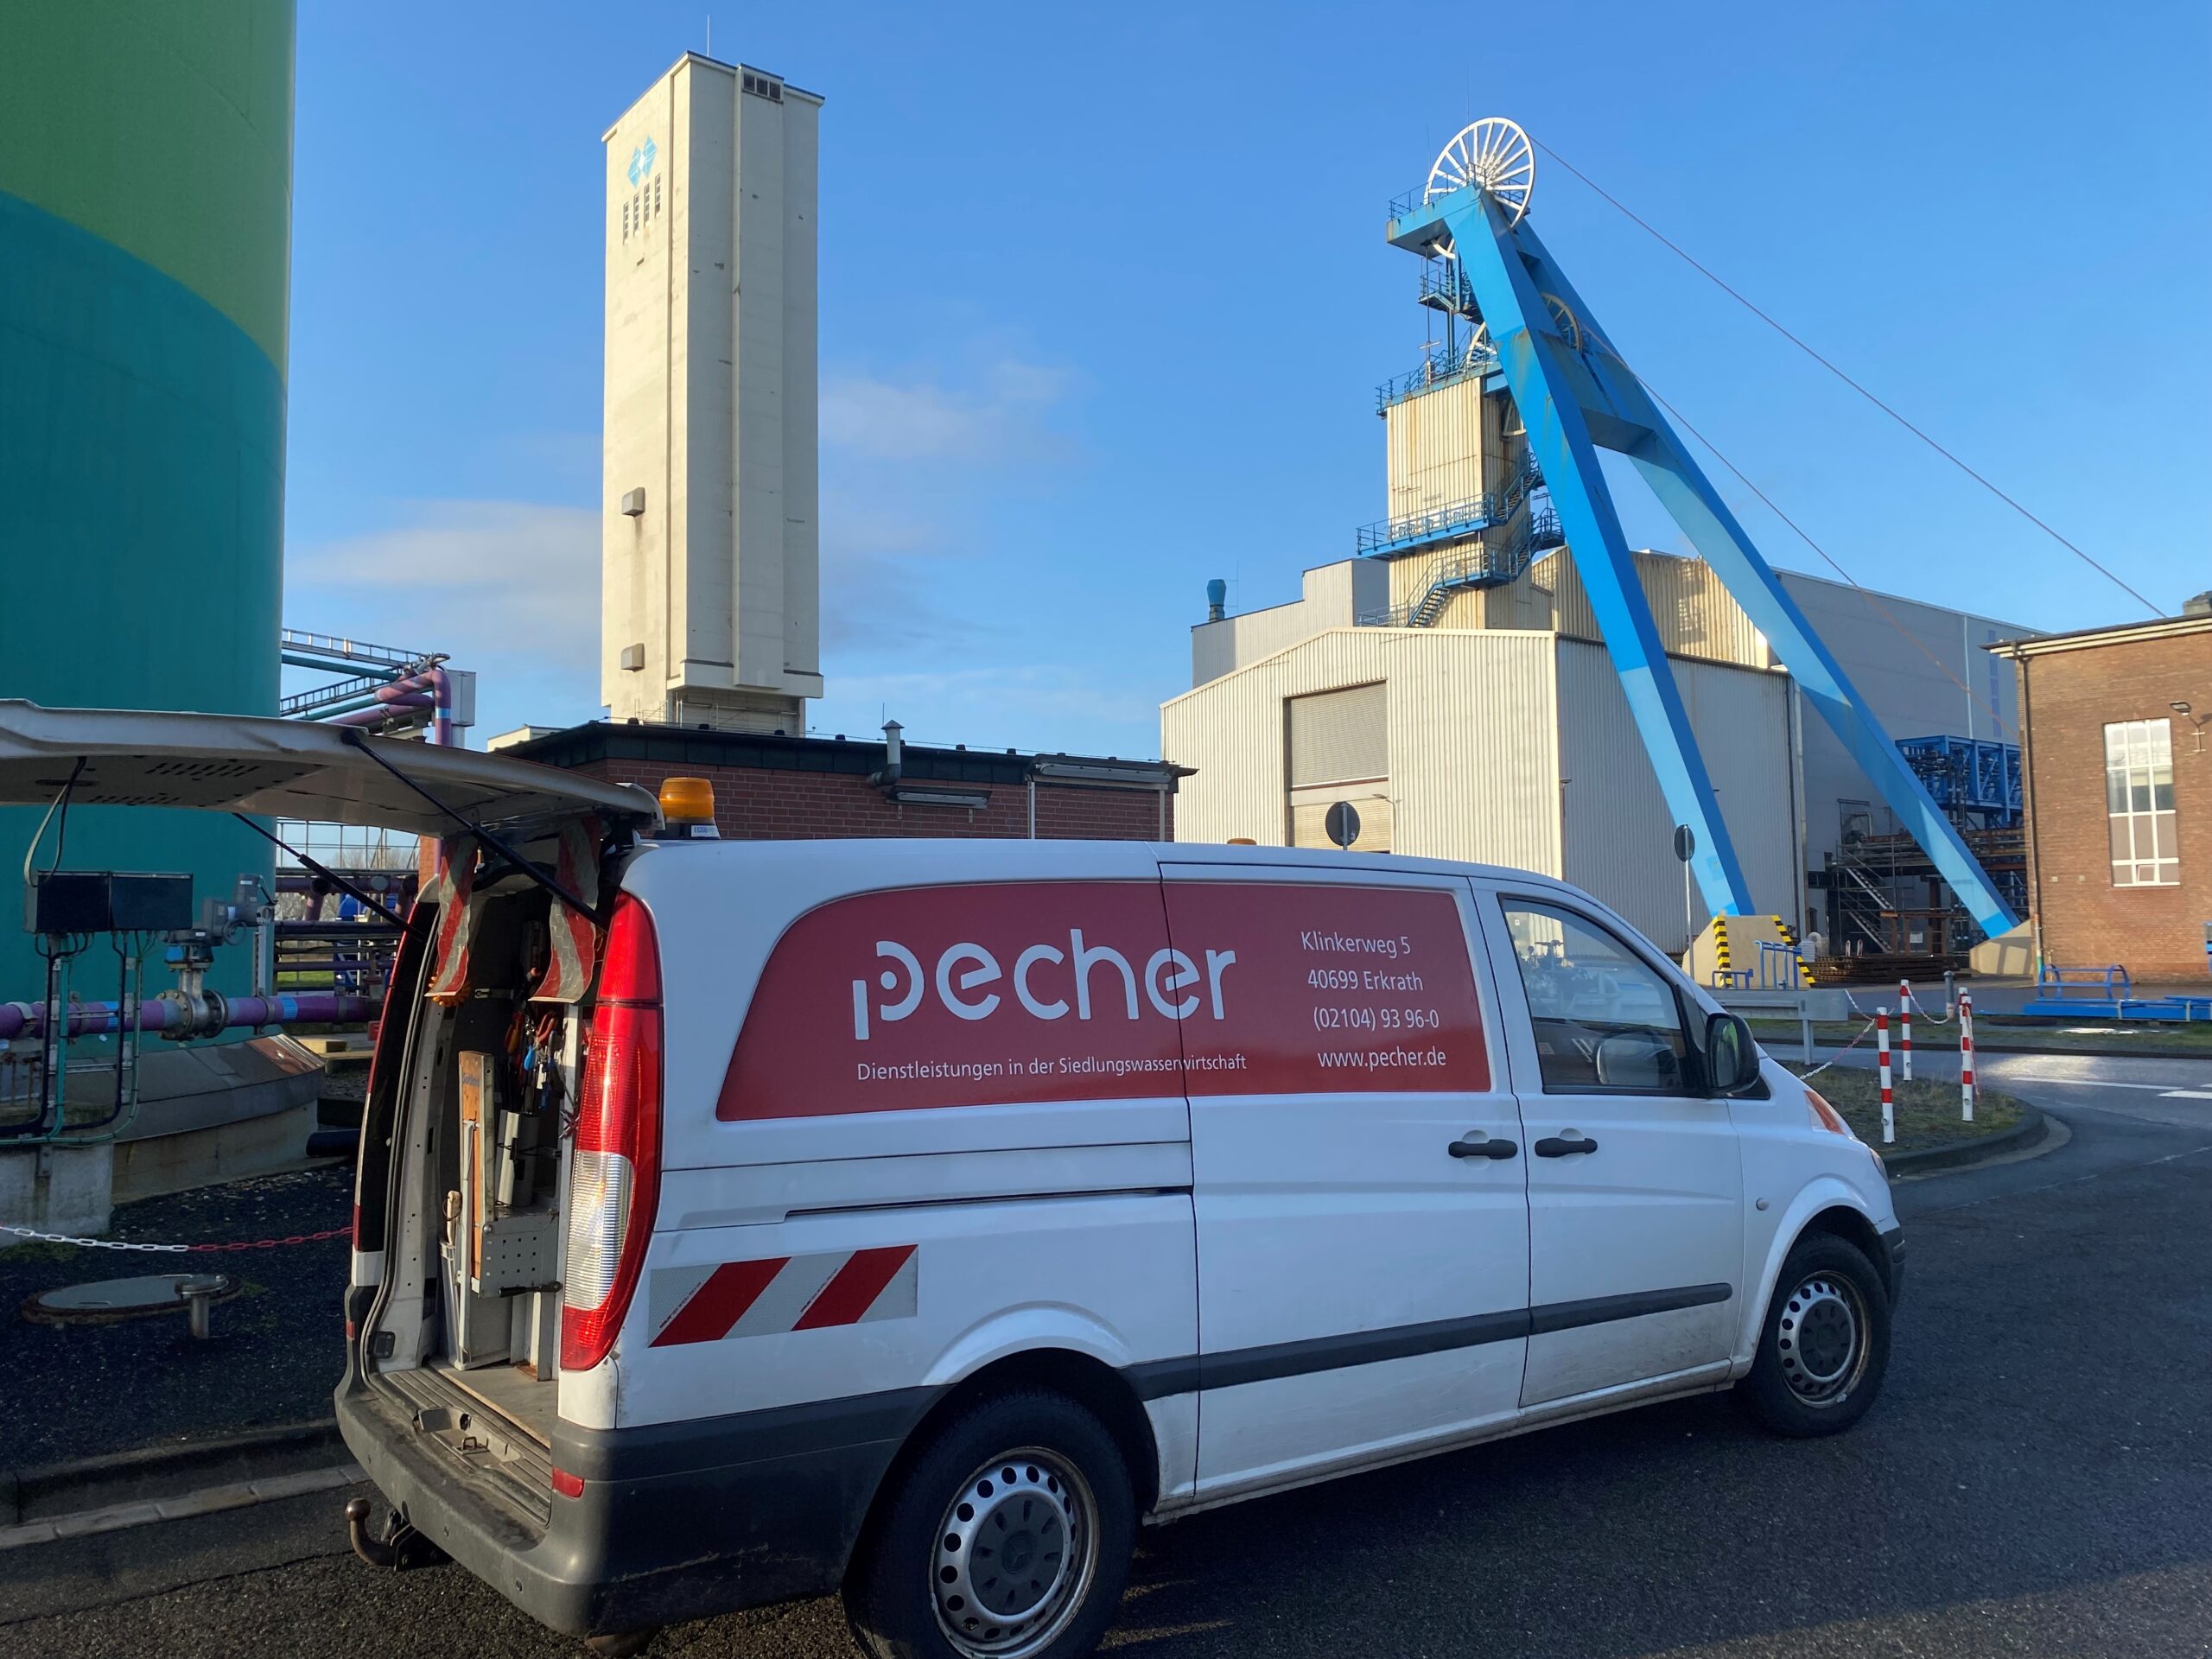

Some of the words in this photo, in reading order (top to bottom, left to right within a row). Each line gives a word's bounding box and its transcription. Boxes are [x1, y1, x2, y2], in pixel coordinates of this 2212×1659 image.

[1300, 931, 1397, 958] Klinkerweg
[1401, 936, 1412, 955] 5
[853, 929, 1236, 1040] pecher
[1307, 969, 1358, 989] 40699
[1363, 970, 1424, 991] Erkrath
[1313, 1006, 1376, 1031] (02104)
[1382, 1008, 1401, 1028] 93
[1405, 1008, 1440, 1028] 96-0
[857, 1060, 1003, 1080] Dienstleistungen
[1008, 1058, 1024, 1075] in
[1028, 1057, 1055, 1074] der
[1059, 1053, 1247, 1077] Siedlungswasserwirtschaft
[1318, 1046, 1447, 1071] www.pecher.de
